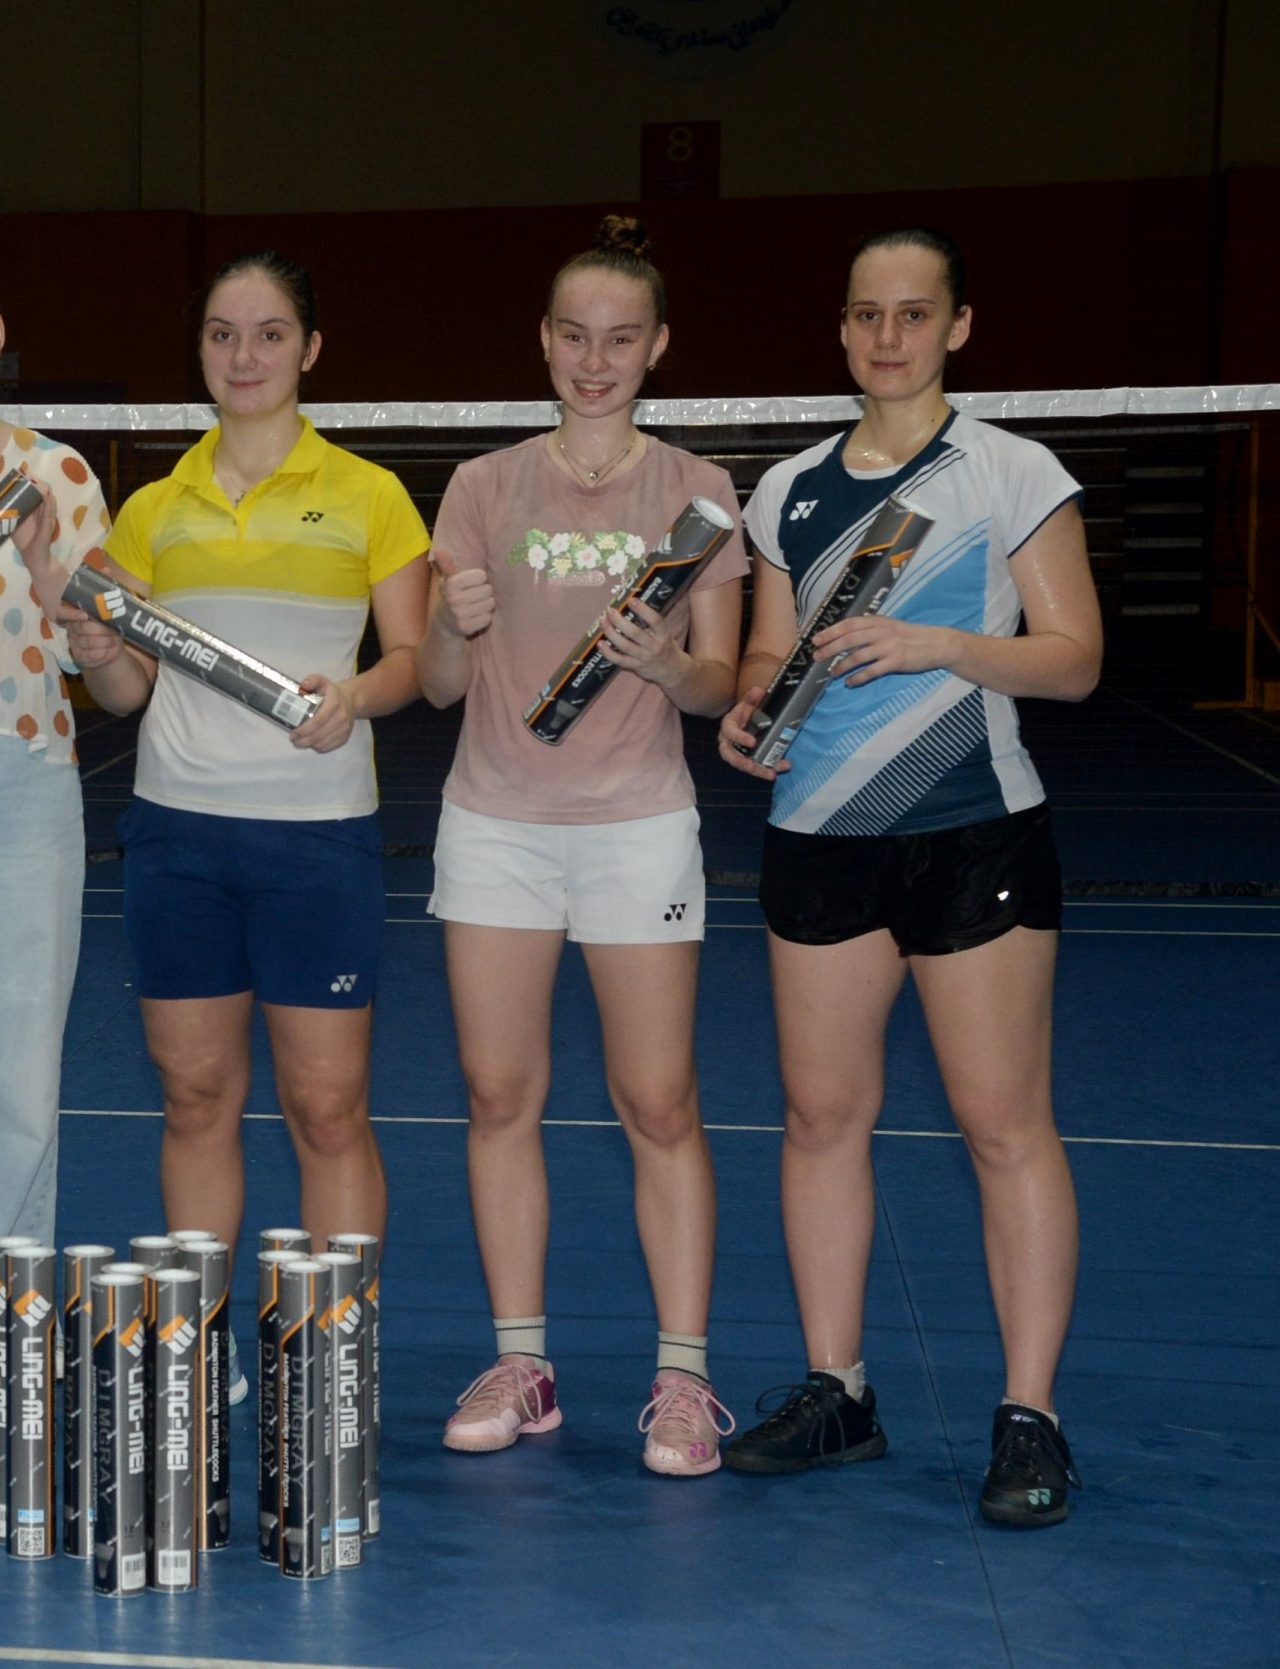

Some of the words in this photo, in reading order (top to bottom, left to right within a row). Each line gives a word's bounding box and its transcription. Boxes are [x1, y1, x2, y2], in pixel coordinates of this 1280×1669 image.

[666, 125, 694, 163] 8
[130, 609, 220, 671] LING-MEI
[211, 1330, 220, 1378] BADMINTON
[21, 1337, 43, 1440] LING-MEI
[128, 1365, 145, 1475] LING-MEI
[167, 1364, 189, 1471] LING-MEI
[211, 1379, 220, 1416] FEATHER
[339, 1343, 359, 1449] LING-MEI
[211, 1417, 220, 1483] SHUTTLECOCKS
